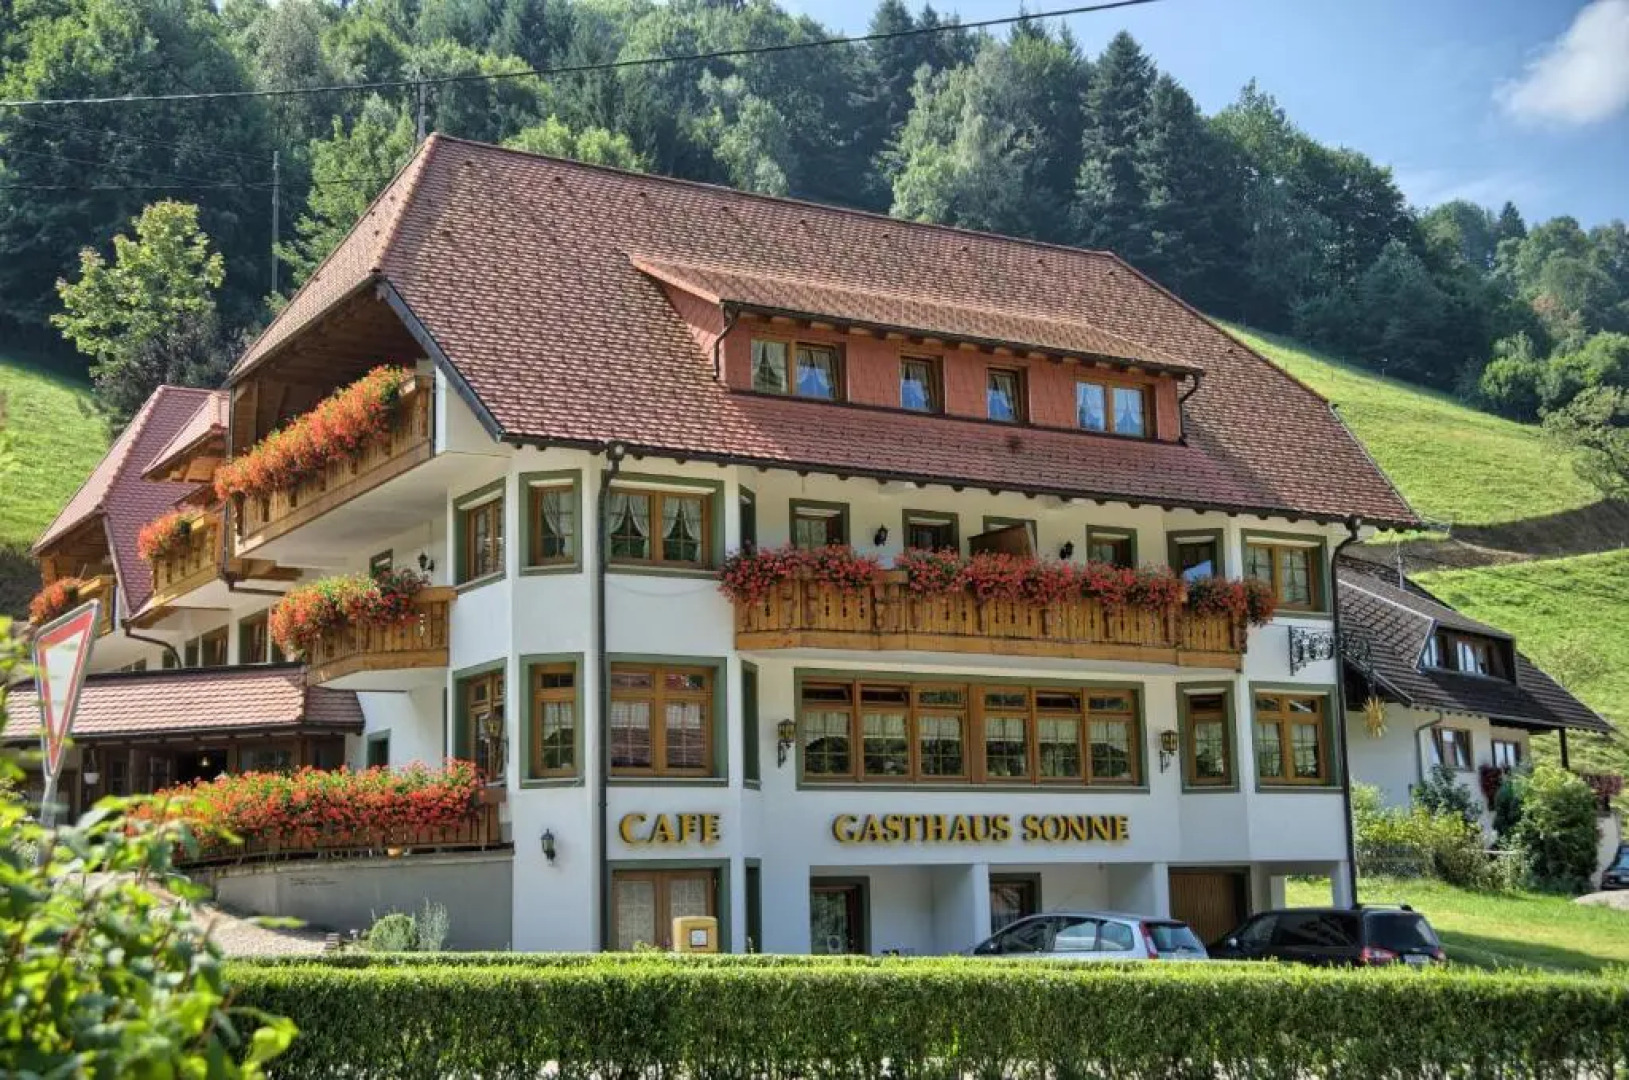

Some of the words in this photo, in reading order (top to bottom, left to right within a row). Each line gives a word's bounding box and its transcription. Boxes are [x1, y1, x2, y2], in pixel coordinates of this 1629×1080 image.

[619, 813, 720, 843] CAFE
[832, 813, 1012, 842] GASTHAUS
[1021, 814, 1129, 842] SONNE
